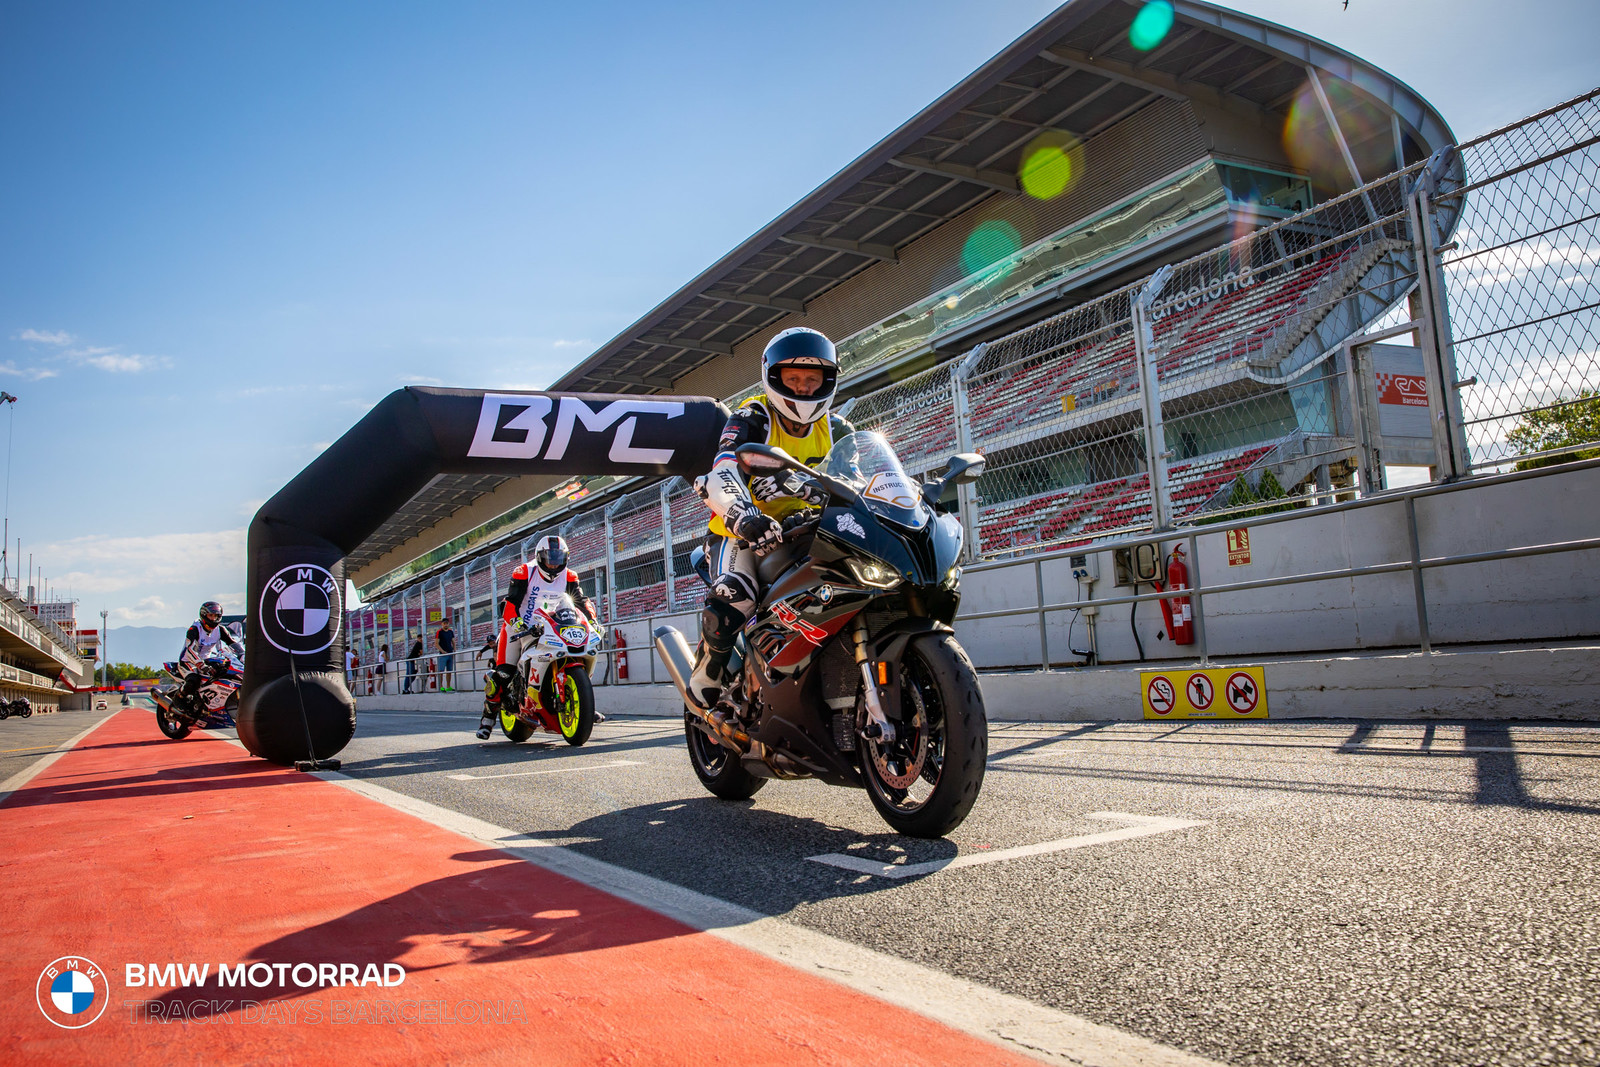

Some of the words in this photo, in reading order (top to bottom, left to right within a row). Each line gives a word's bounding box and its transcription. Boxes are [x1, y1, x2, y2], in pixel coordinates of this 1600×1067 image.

[1151, 266, 1255, 320] arcelona
[896, 382, 952, 416] Barcelon
[1402, 396, 1428, 406] Barcelona
[467, 393, 685, 465] BMC
[872, 482, 908, 494] INSTRUCT
[270, 568, 336, 594] BMW
[567, 630, 583, 639] 163
